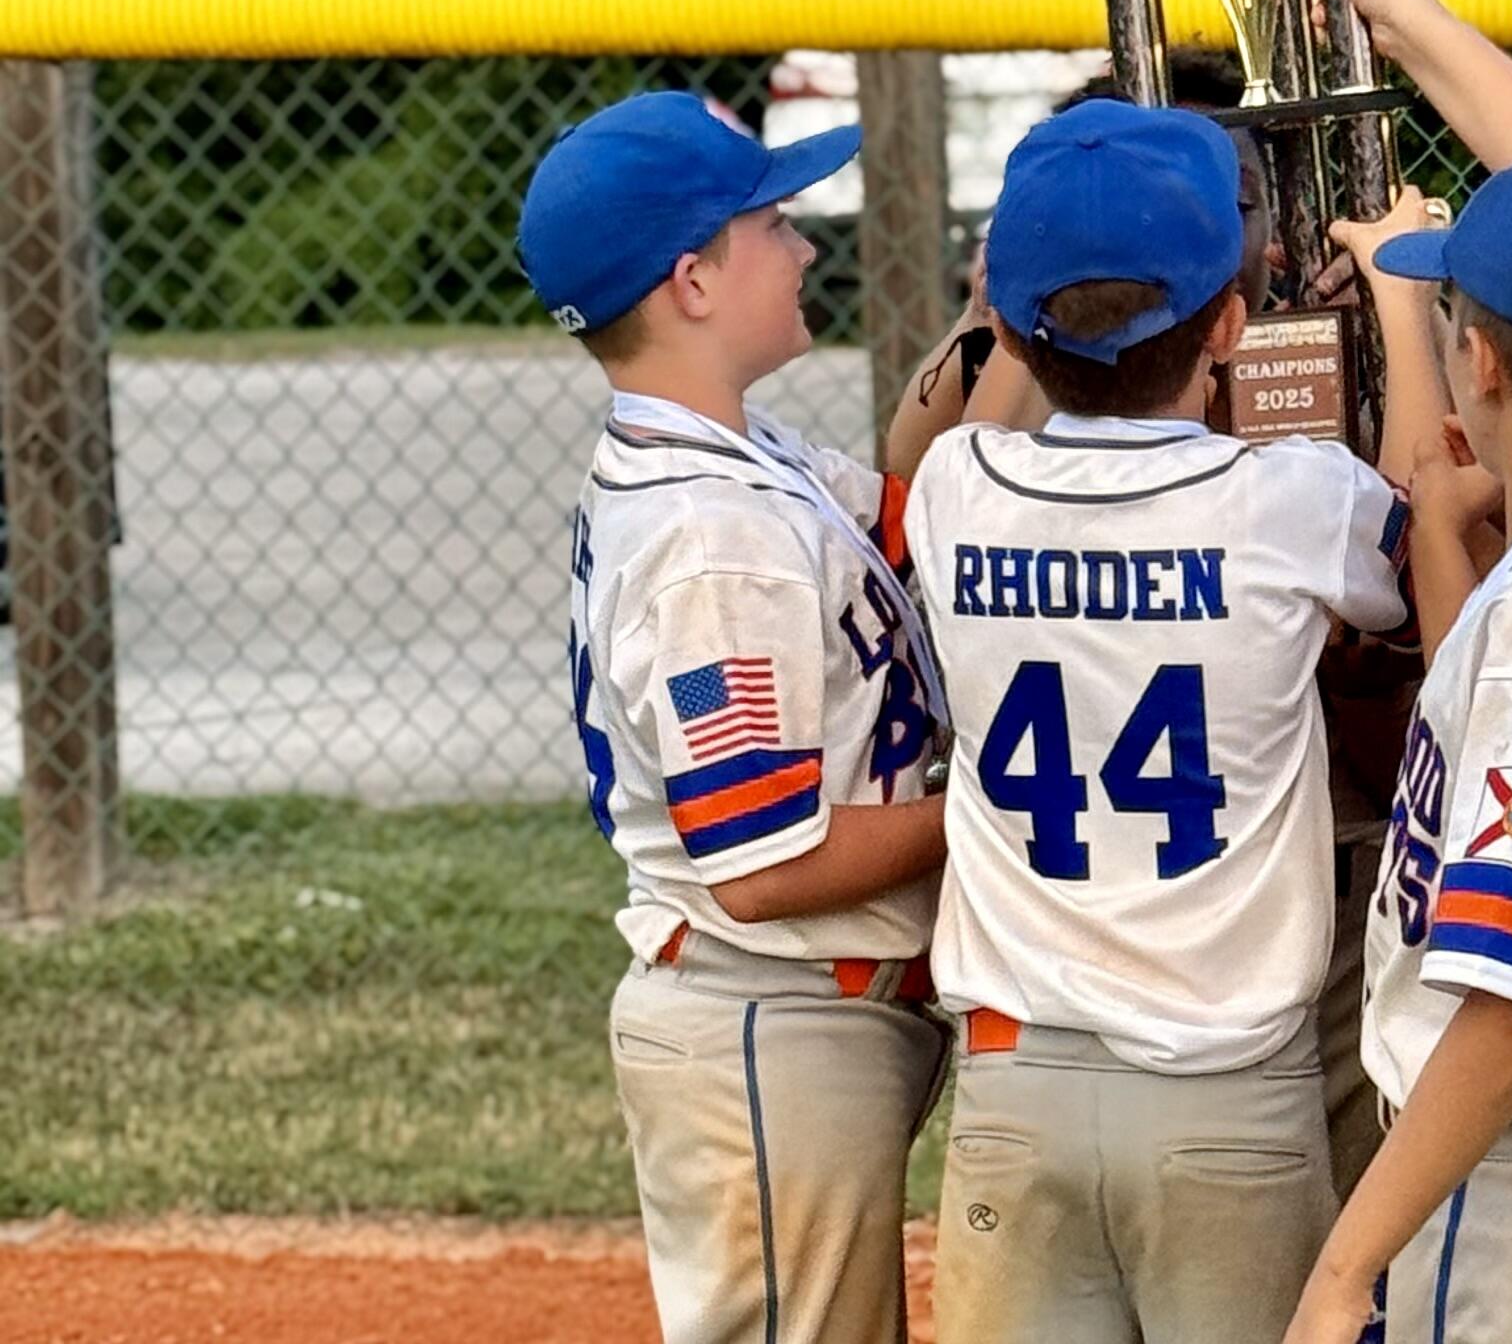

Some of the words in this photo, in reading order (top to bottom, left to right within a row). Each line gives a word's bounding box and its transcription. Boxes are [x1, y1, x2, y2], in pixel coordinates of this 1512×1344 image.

[1234, 357, 1338, 380] CHAMPIONS
[1254, 385, 1315, 411] 2025
[953, 543, 1230, 621] RHODEN
[977, 660, 1229, 882] 44
